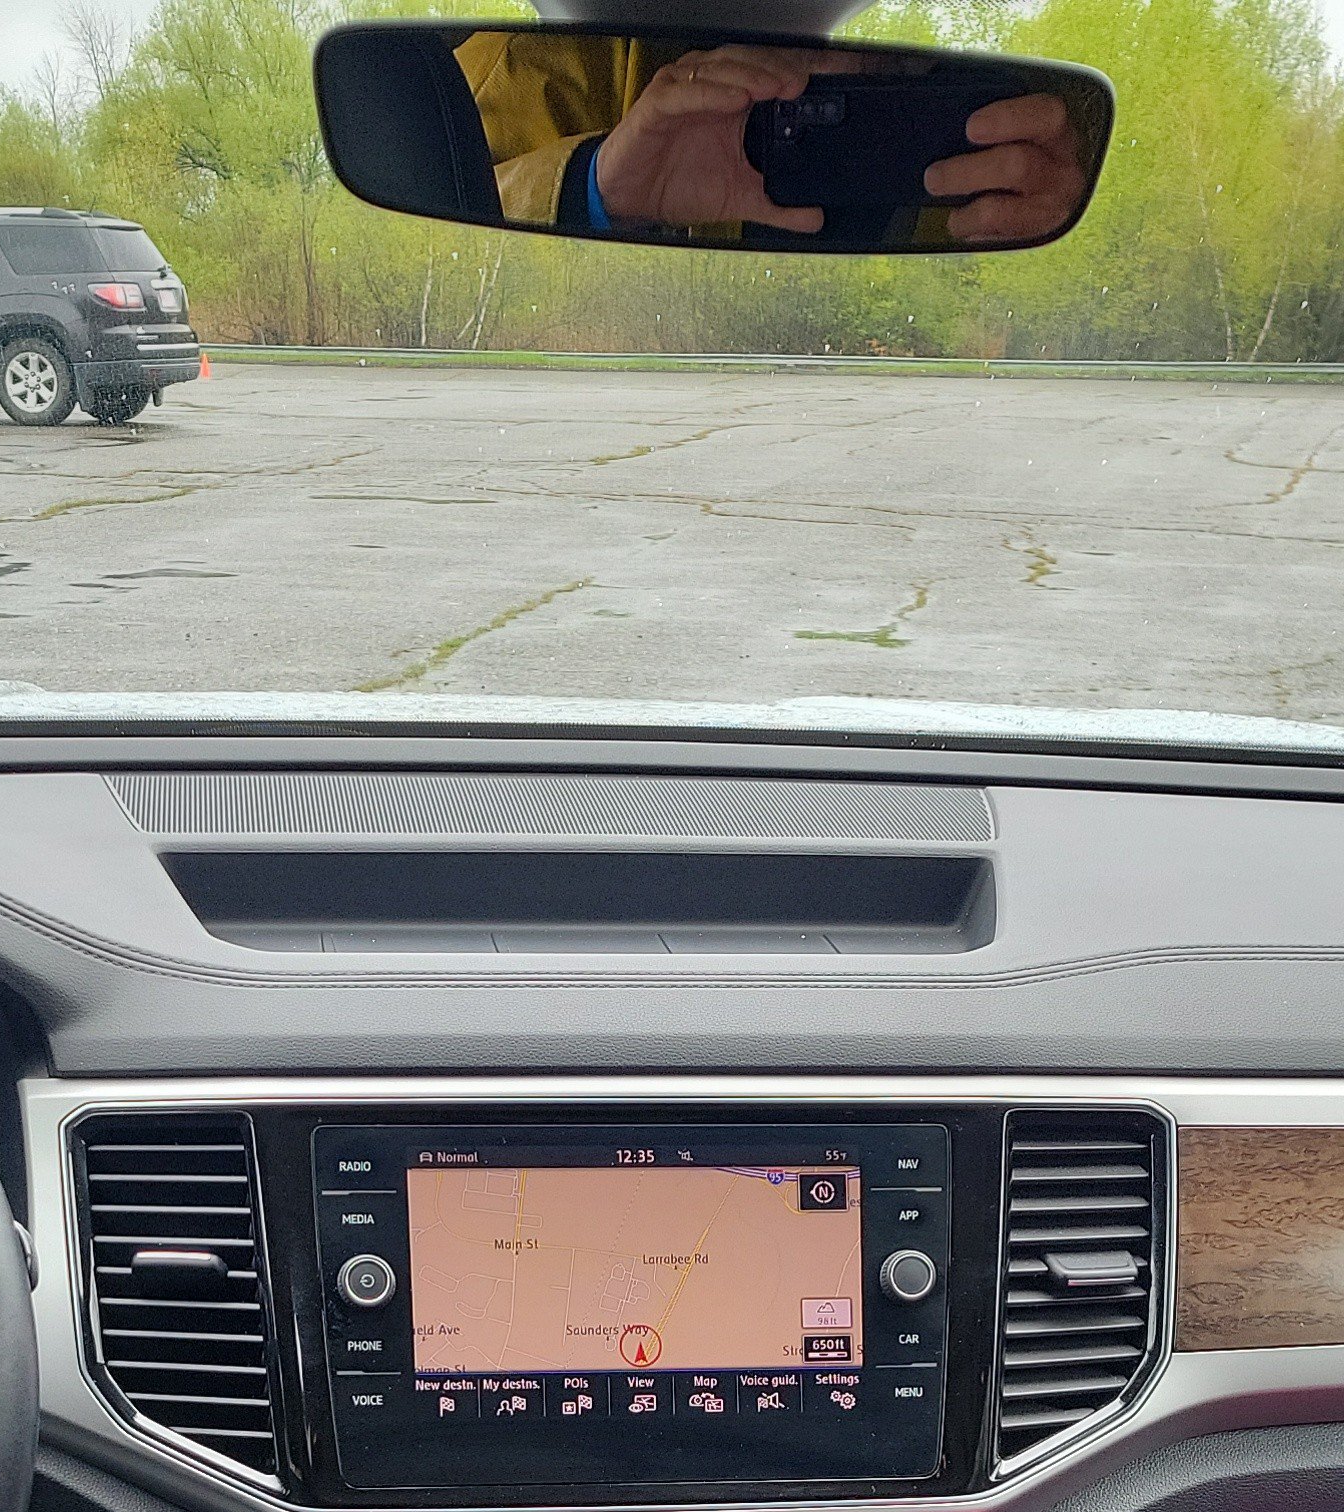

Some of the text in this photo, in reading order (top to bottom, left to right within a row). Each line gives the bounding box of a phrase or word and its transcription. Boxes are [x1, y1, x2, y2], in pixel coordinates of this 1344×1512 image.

[437, 1151, 479, 1163] Normal
[616, 1150, 655, 1163] 12:35
[339, 1161, 372, 1172] RADIO
[897, 1158, 919, 1170] NAV
[770, 1172, 781, 1183] 95
[819, 1186, 829, 1198] N
[342, 1214, 375, 1225] MEDIA
[899, 1210, 919, 1221] APP
[494, 1239, 539, 1250] Main St
[643, 1253, 709, 1265] Larrabee Rd
[438, 1325, 460, 1335] Ave
[566, 1324, 649, 1337] Saunders Way
[899, 1334, 920, 1344] CAR
[347, 1340, 382, 1352] PHONE
[416, 1378, 476, 1391] New destn.
[482, 1378, 540, 1393] My destns.
[564, 1377, 589, 1390] POIs
[628, 1376, 654, 1388] View
[693, 1376, 718, 1389] Map
[740, 1374, 799, 1388] Voice guid.
[815, 1373, 860, 1387] Settings
[895, 1387, 923, 1398] MENU
[352, 1394, 384, 1406] VOICE
